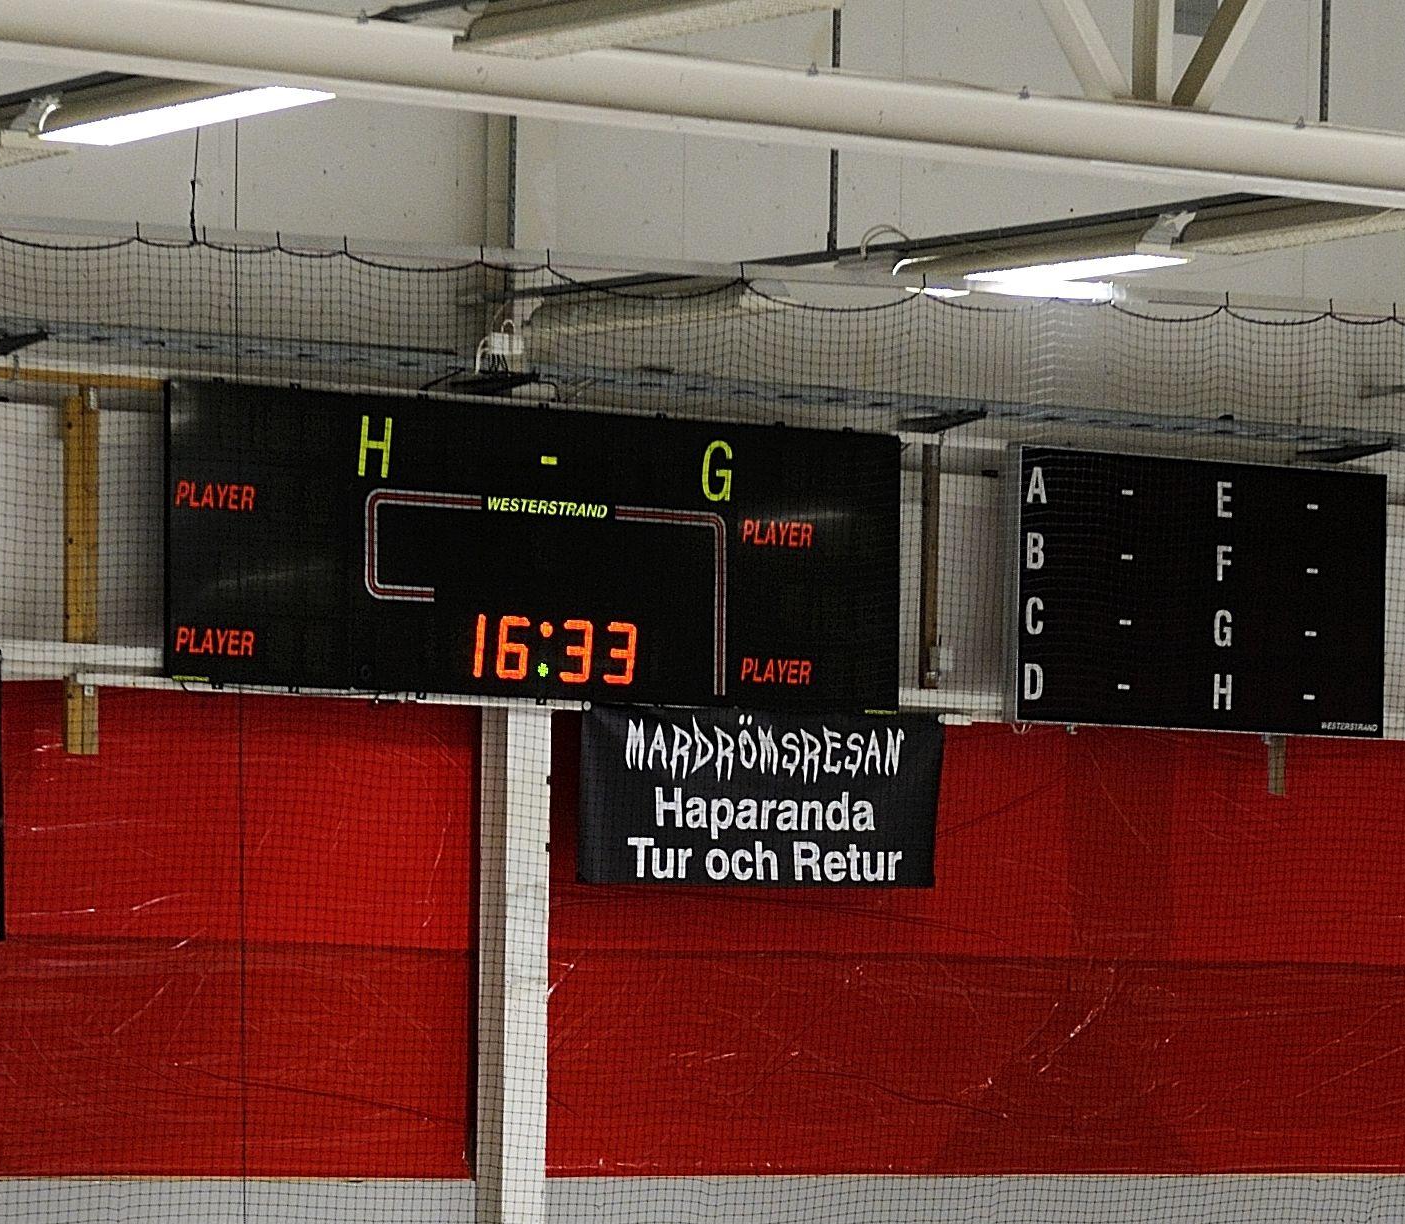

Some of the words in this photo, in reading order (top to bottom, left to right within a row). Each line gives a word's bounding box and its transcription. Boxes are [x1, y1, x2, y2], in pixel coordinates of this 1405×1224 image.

[358, 415, 393, 478] H
[701, 440, 733, 502] G
[175, 480, 255, 511] PLAYER
[1026, 466, 1047, 504] A
[1216, 481, 1233, 518] E
[487, 496, 609, 518] WESTERSTRAND
[742, 520, 814, 548] PLAYER
[1026, 532, 1044, 570] B
[1216, 545, 1232, 581] F
[1025, 596, 1044, 635] C
[1213, 609, 1232, 647] G
[175, 627, 255, 658] PLAYER
[472, 613, 638, 686] 16:33
[740, 657, 813, 686] PLAYER
[1024, 663, 1044, 700] D
[1213, 673, 1233, 711] H
[625, 714, 905, 785] MARDRÖMSRESAN
[654, 787, 876, 840] Haparanda
[627, 837, 692, 879] Tur
[705, 841, 779, 881] och
[793, 841, 903, 882] Retur
